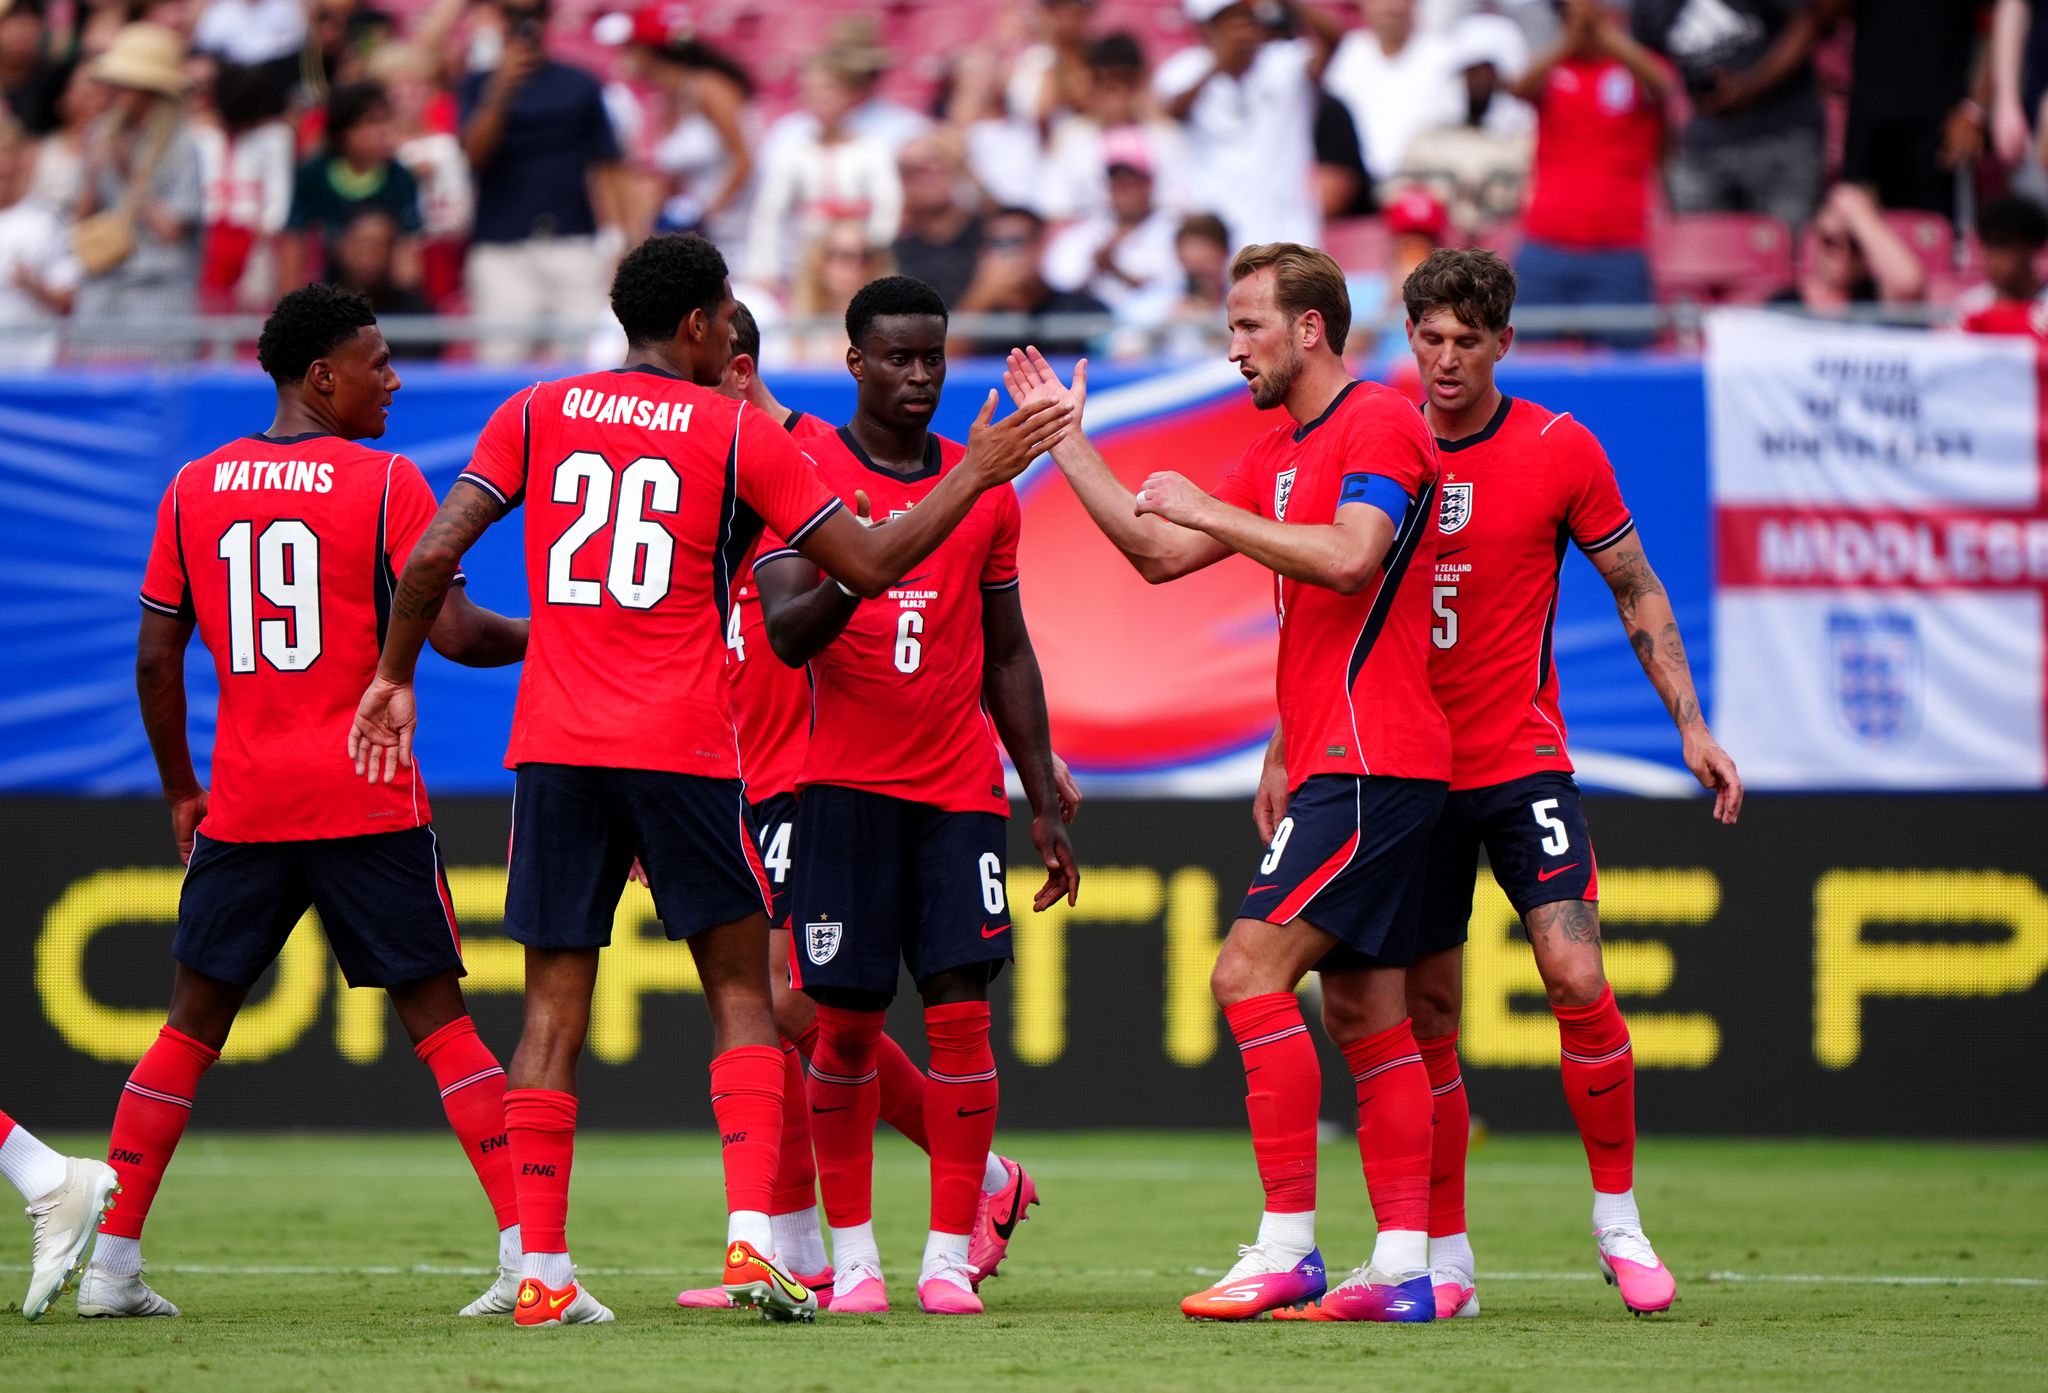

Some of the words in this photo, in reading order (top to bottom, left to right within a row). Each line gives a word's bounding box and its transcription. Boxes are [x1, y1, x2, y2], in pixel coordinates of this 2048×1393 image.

[562, 387, 694, 433] QUANSAH
[213, 460, 335, 494] WATKINS
[1341, 475, 1369, 500] C
[547, 450, 682, 611] 26
[217, 519, 322, 675] 19
[888, 590, 905, 599] NEW
[905, 590, 938, 599] ZEALAND
[1440, 563, 1472, 572] ZEALAND
[726, 602, 746, 664] 4
[893, 609, 925, 675] 6
[1432, 585, 1458, 650] 5
[759, 822, 793, 883] 4
[1260, 816, 1295, 875] 9
[1531, 798, 1570, 857] 5
[978, 852, 1005, 915] 6
[110, 1147, 144, 1166] ENG
[522, 1163, 556, 1177] ENG
